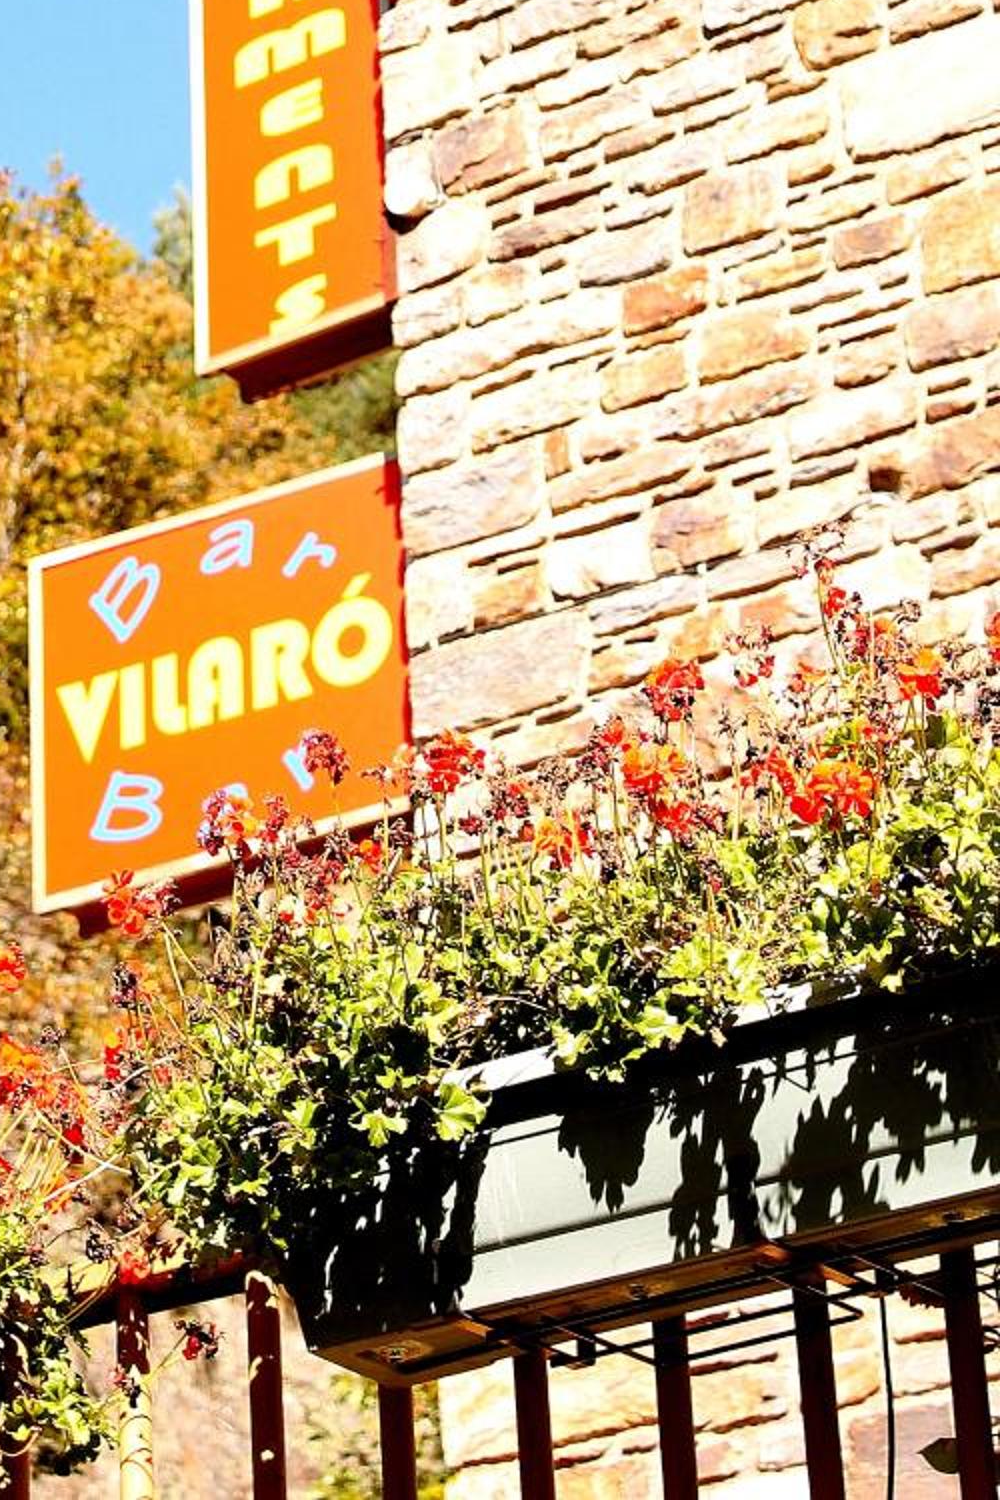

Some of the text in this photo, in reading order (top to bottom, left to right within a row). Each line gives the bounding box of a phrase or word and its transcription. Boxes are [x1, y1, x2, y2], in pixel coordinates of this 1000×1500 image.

[89, 518, 337, 644] Bar
[55, 572, 394, 766] VILARÓ
[89, 742, 316, 843] Br
